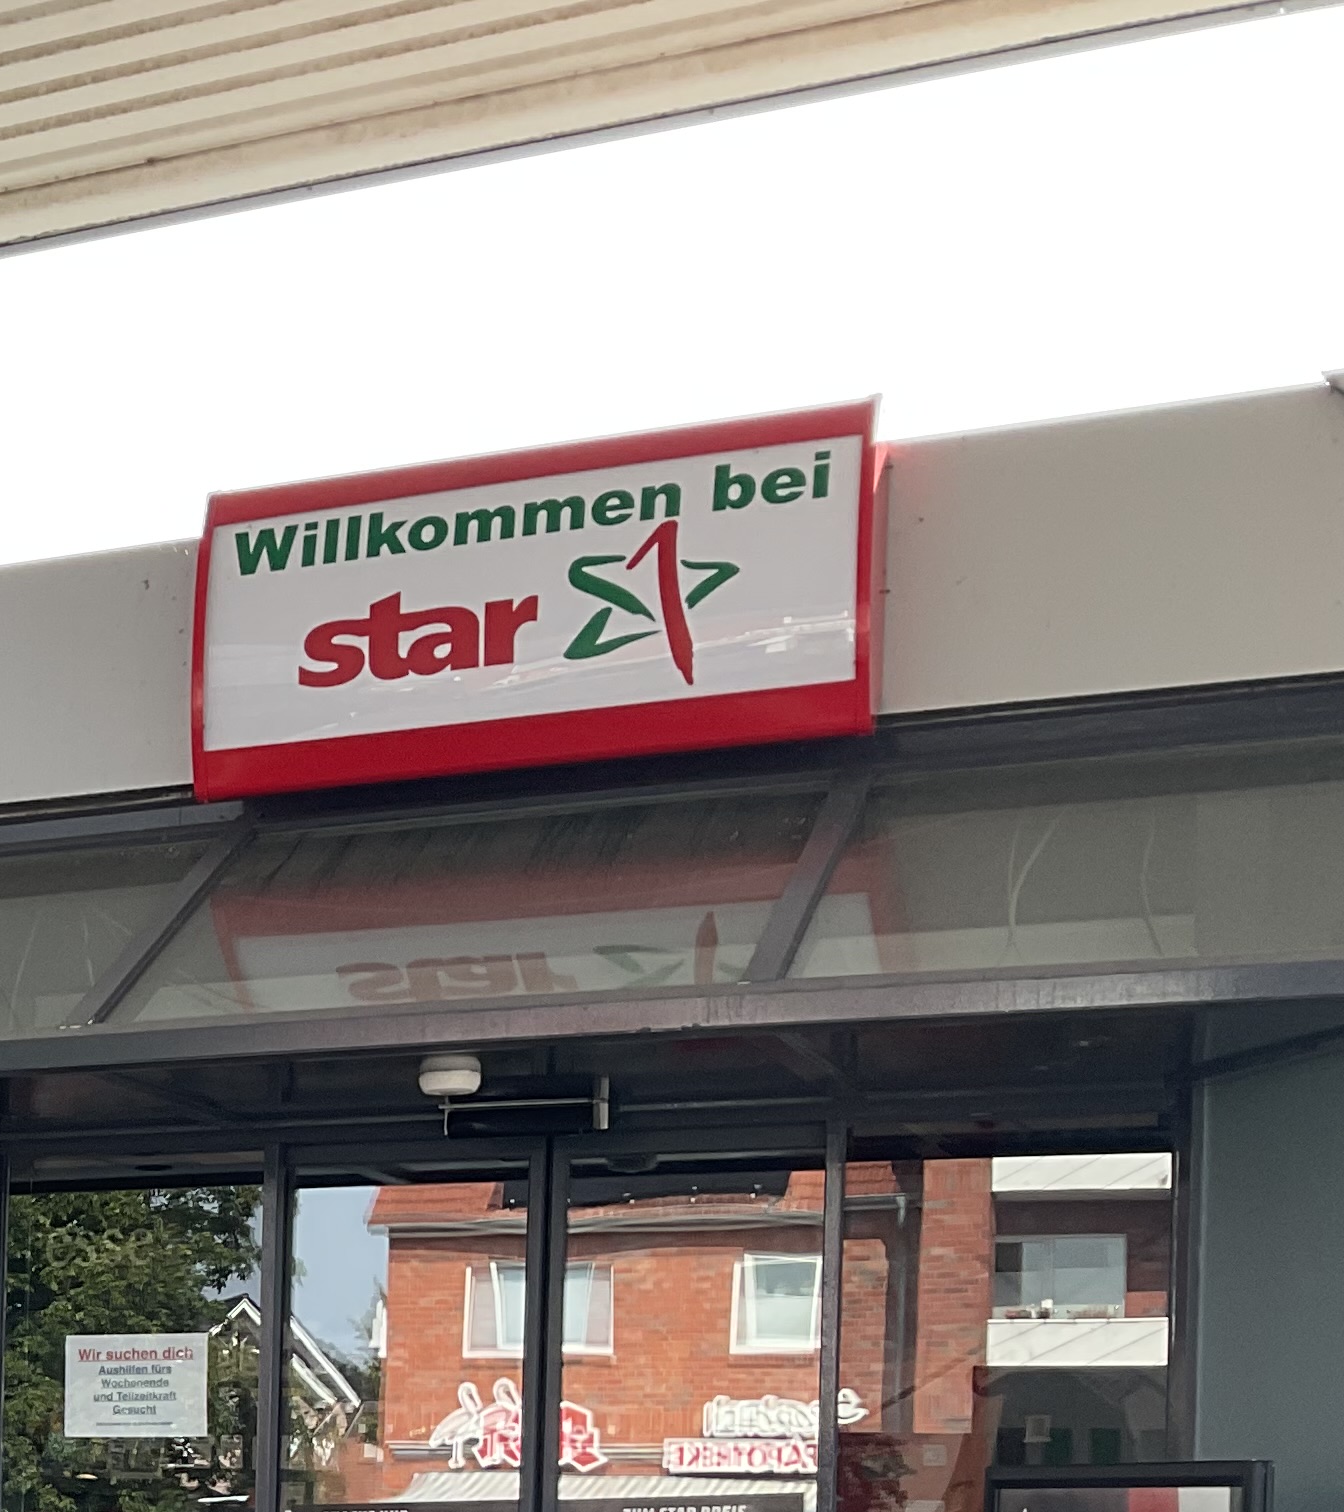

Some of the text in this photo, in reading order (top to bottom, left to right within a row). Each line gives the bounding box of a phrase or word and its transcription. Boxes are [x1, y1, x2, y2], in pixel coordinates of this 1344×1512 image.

[233, 450, 832, 577] Willkommen bei
[298, 590, 539, 688] star
[78, 1347, 194, 1361] Wir suchen dich
[98, 1364, 173, 1376] Aushilfen fürs
[101, 1378, 170, 1388] Wochenende
[93, 1392, 113, 1402] und
[112, 1405, 157, 1415] Gesucht
